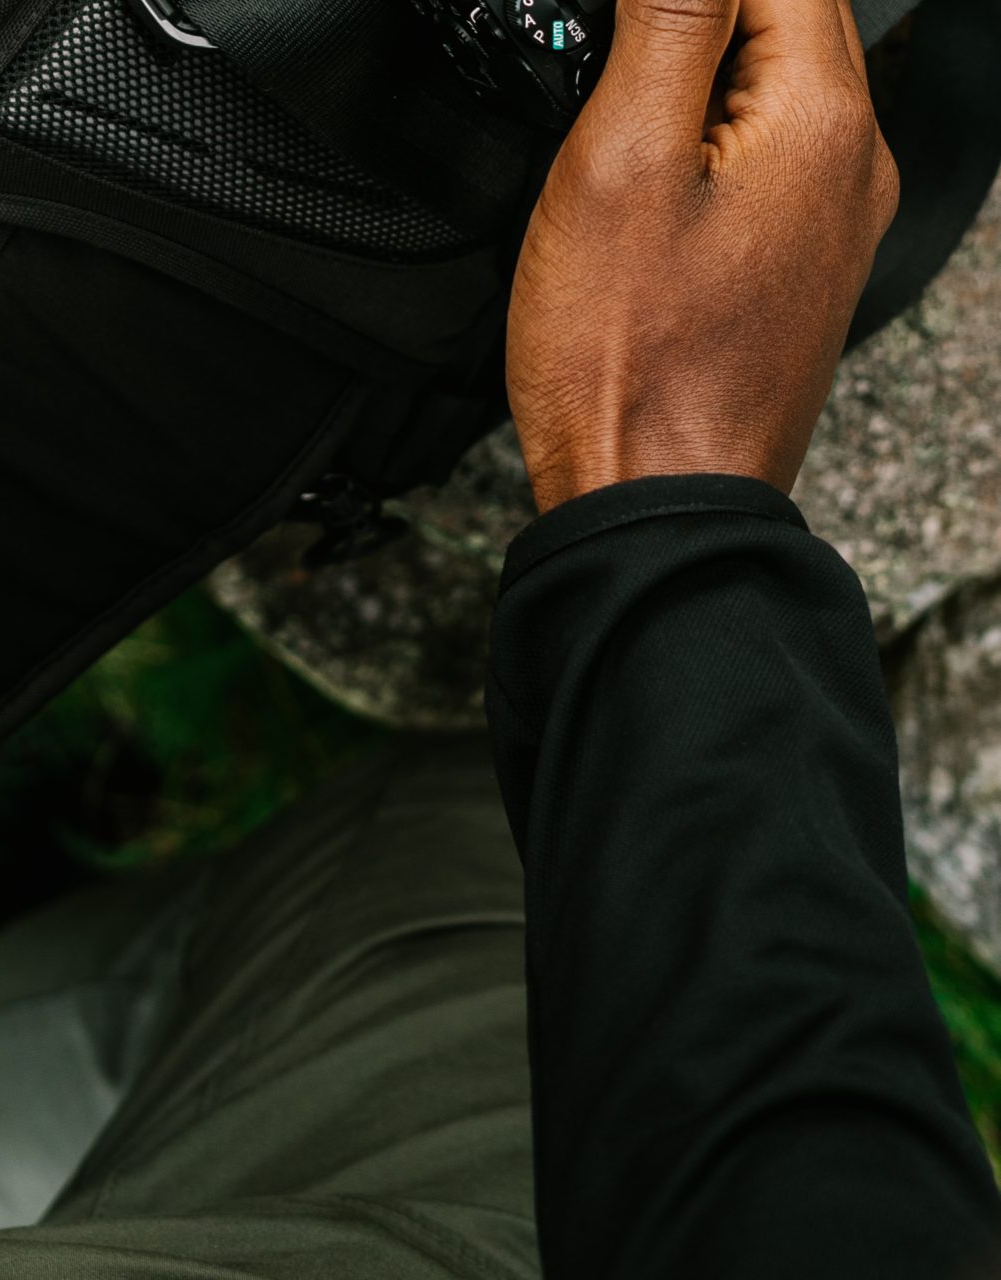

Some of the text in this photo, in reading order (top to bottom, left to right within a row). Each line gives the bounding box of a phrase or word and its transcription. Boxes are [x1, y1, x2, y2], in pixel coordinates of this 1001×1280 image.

[525, 14, 536, 28] A
[533, 30, 545, 43] P
[553, 21, 563, 47] AUTO
[565, 19, 586, 42] SCN
